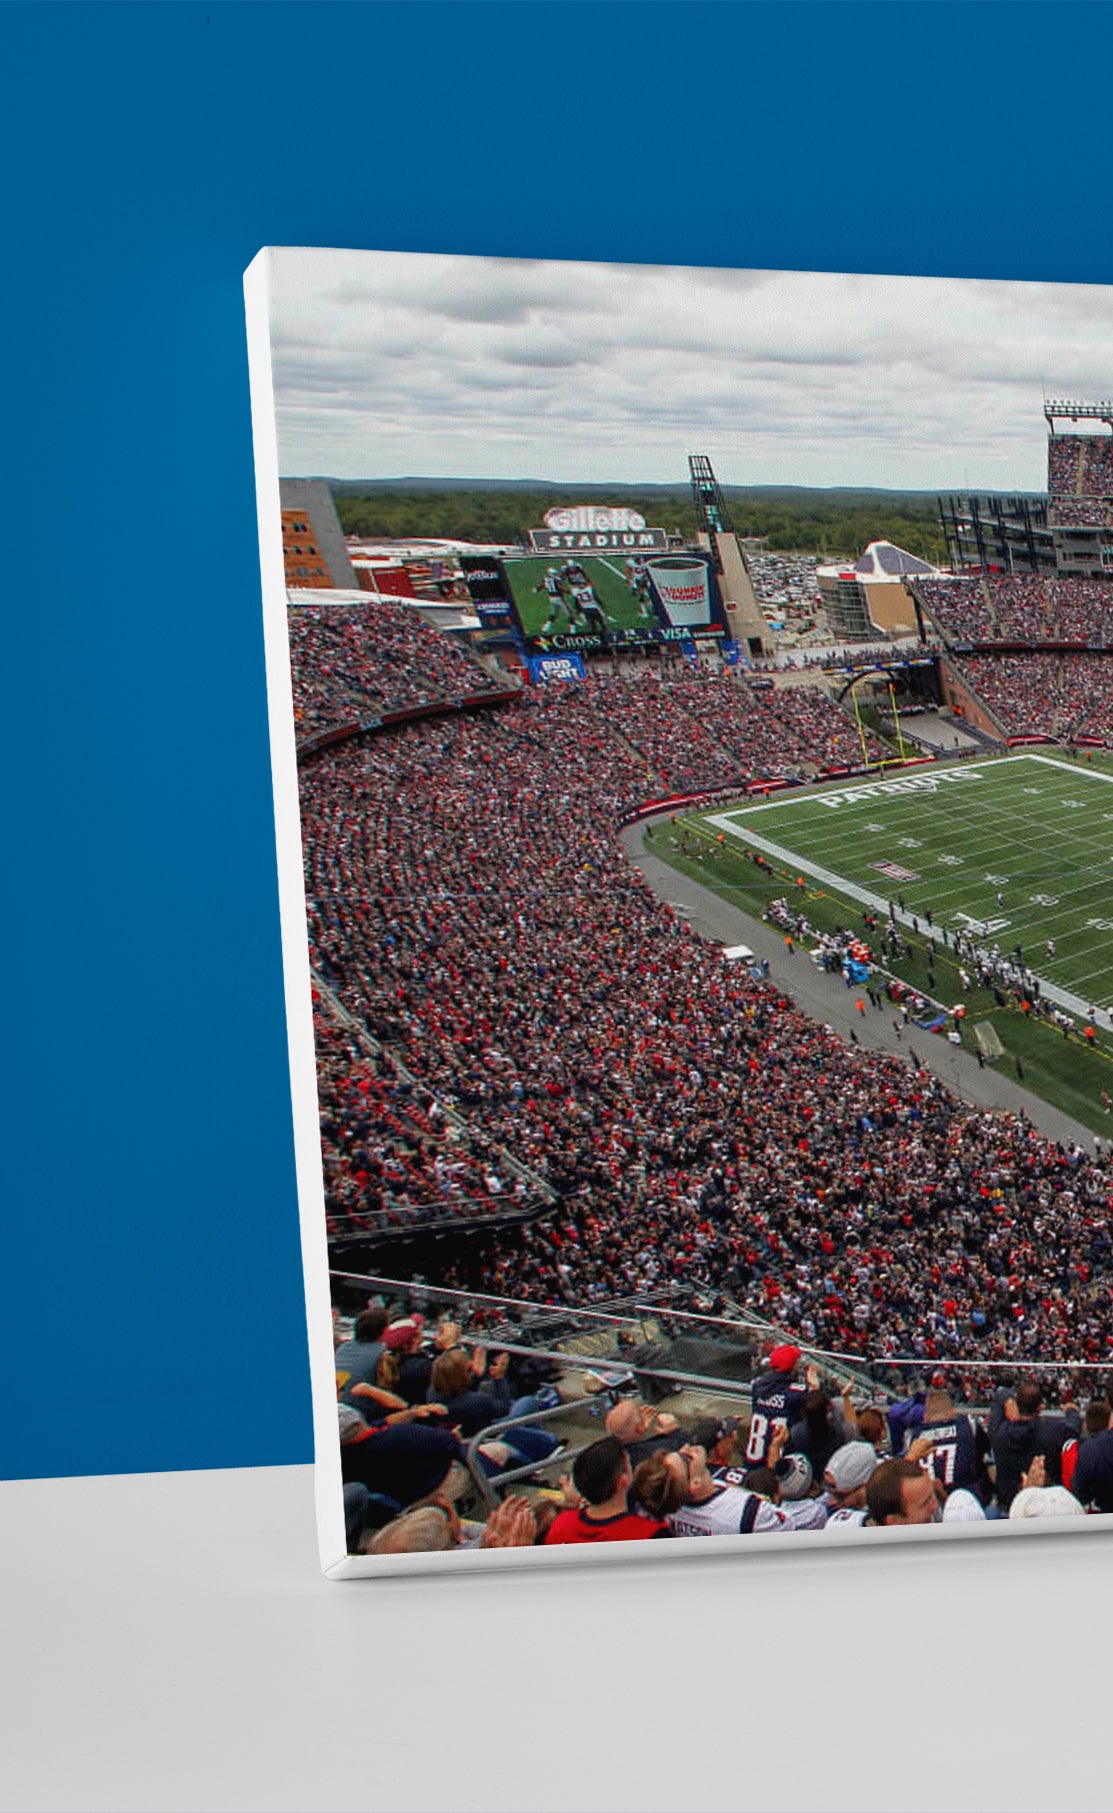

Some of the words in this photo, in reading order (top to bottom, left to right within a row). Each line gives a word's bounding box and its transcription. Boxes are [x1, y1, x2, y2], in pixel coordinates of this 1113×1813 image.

[549, 533, 655, 547] STADIUM
[661, 627, 692, 640] VISA
[820, 769, 984, 808] PATRIOTS
